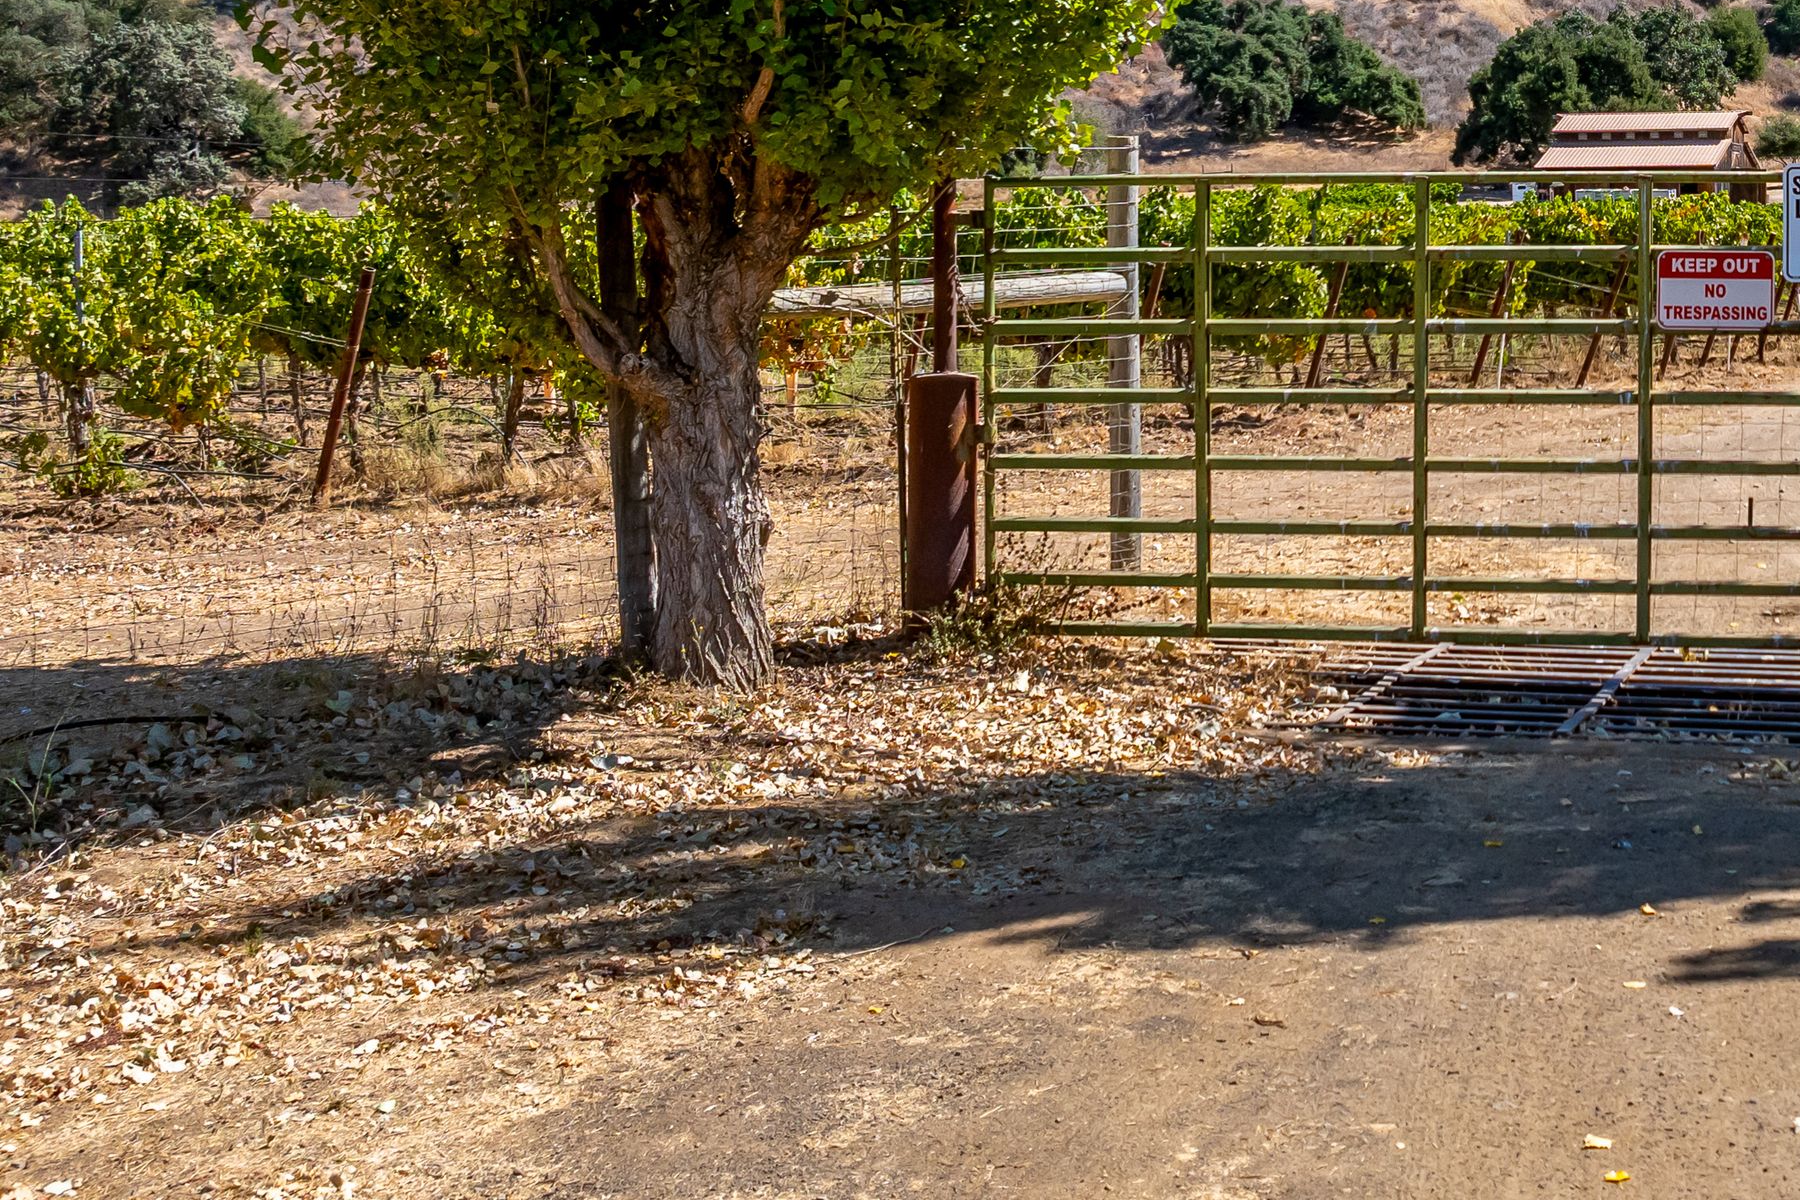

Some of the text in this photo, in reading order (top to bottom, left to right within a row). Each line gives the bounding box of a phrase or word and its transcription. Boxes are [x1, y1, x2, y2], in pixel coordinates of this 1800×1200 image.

[1671, 257, 1760, 274] KEEP OUT
[1704, 284, 1727, 299] NO
[1664, 305, 1768, 321] TRESPASSING
